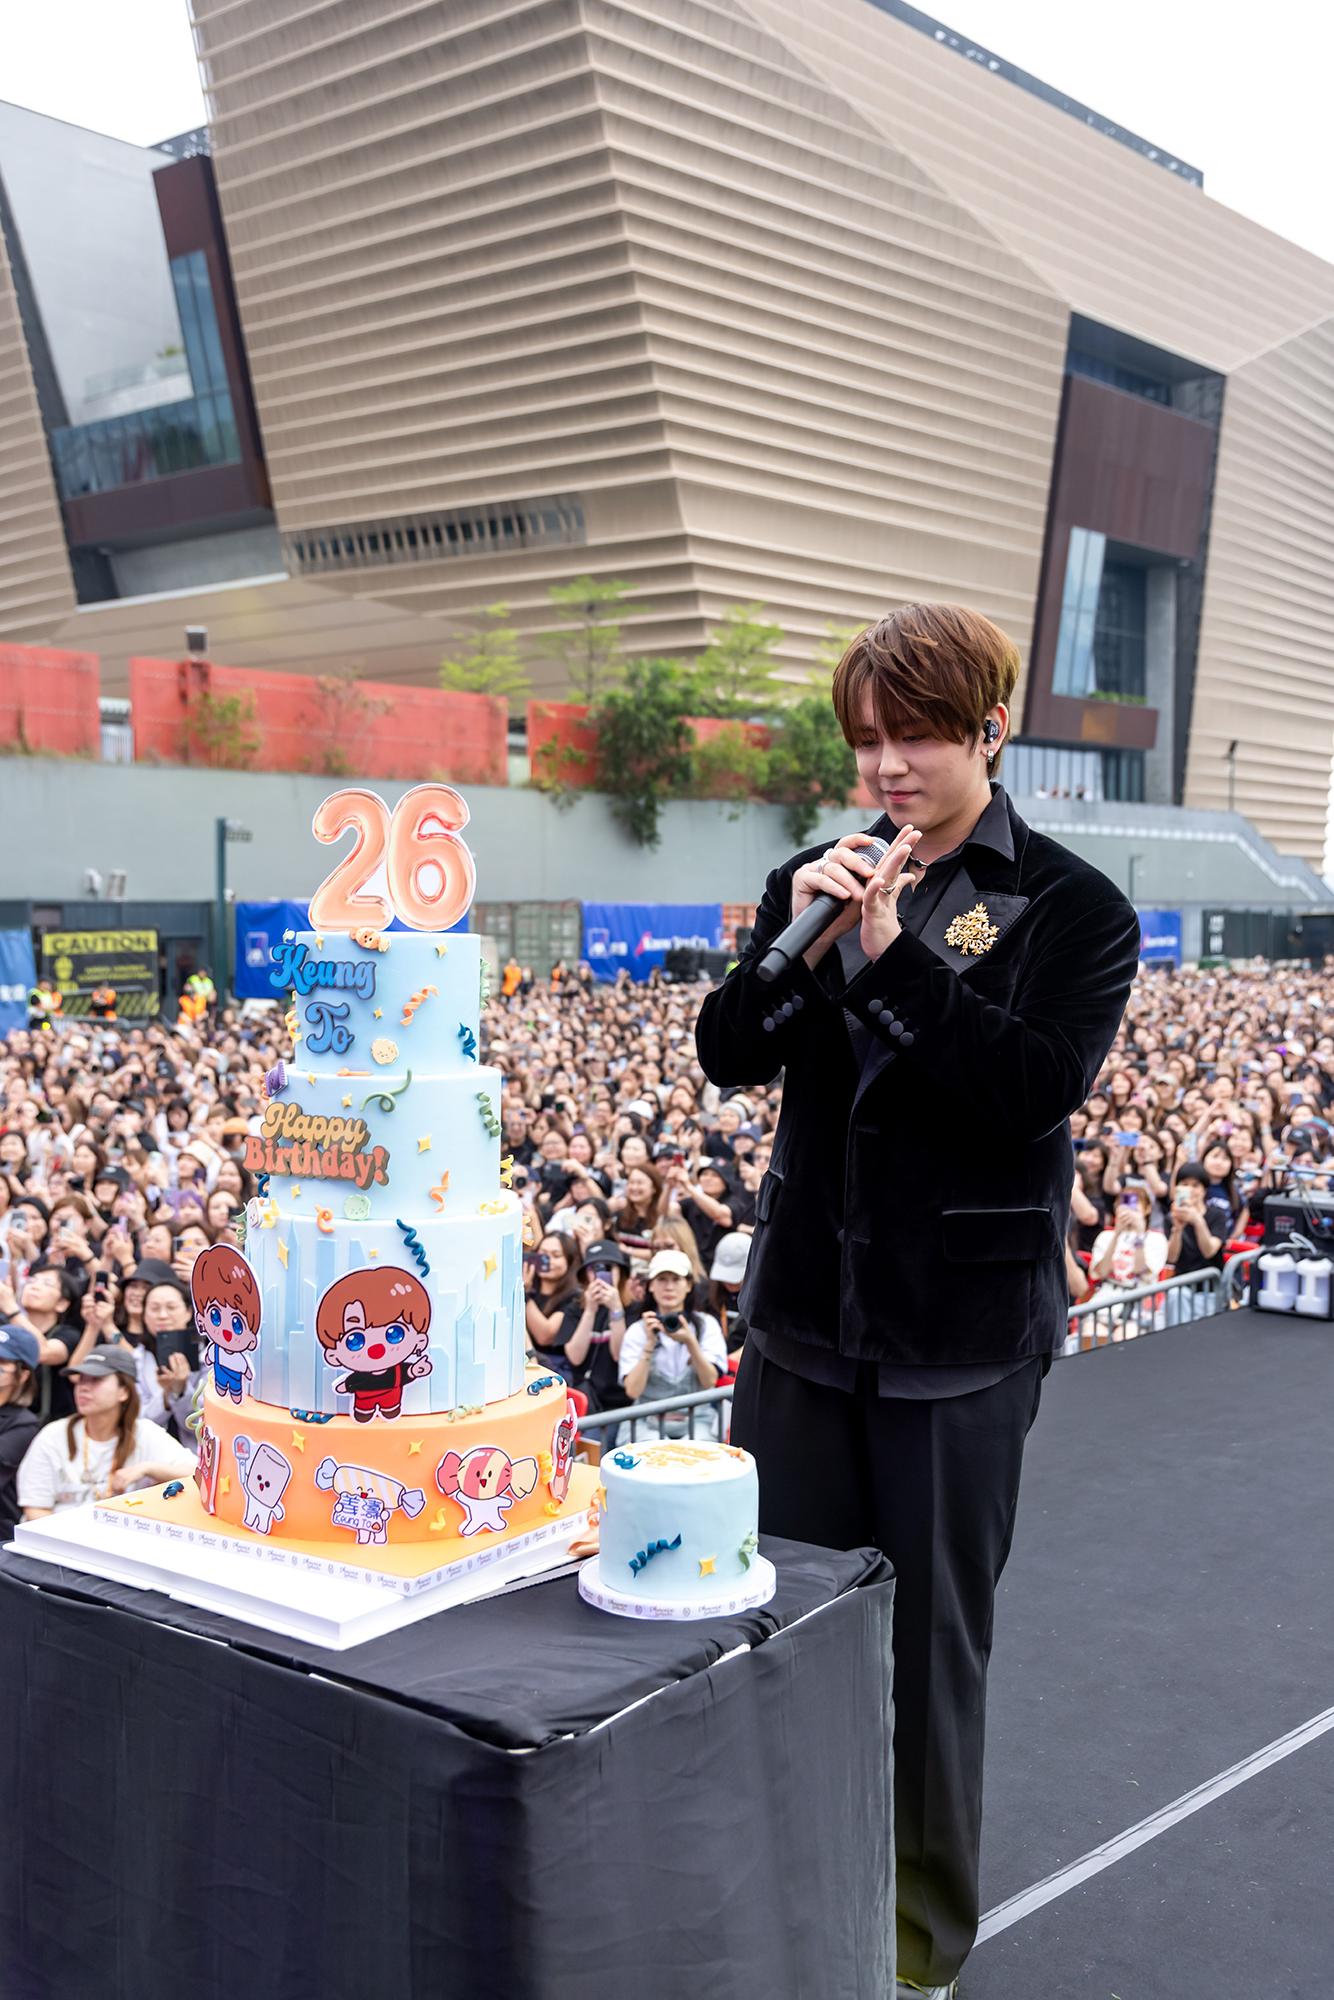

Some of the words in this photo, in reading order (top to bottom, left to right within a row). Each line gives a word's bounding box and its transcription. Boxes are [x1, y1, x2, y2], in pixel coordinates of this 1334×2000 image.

[308, 783, 477, 932] 26
[53, 936, 149, 952] CAUTION
[269, 943, 377, 1000] Keung
[305, 1001, 355, 1054] To
[261, 1101, 370, 1153] Happy
[243, 1136, 390, 1190] Birthday!
